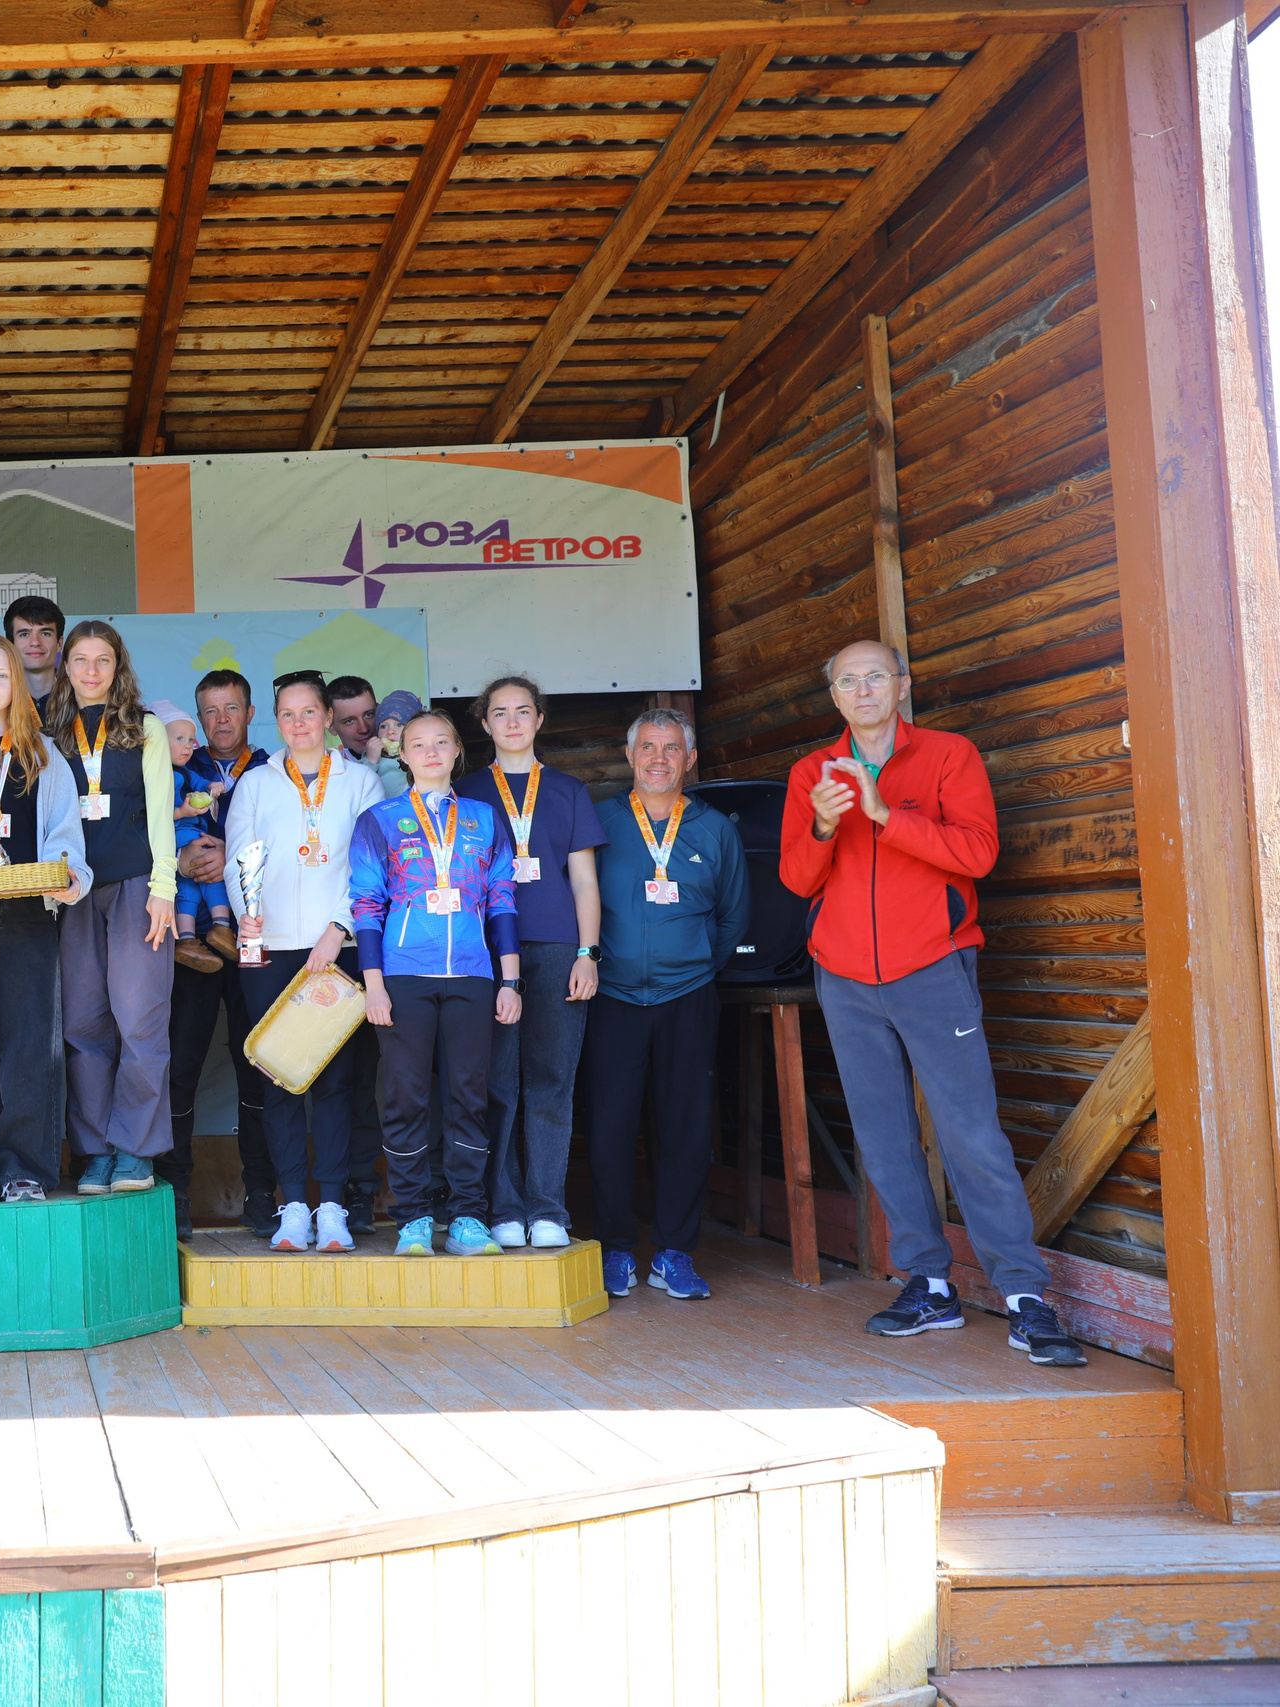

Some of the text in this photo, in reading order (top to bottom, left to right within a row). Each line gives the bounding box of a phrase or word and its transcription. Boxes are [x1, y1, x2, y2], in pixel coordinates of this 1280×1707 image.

[387, 519, 510, 548] РОЗА
[483, 535, 642, 563] ВЕТРОВ
[2, 825, 8, 834] 1
[320, 854, 328, 863] 3
[531, 869, 539, 878] 3
[670, 892, 678, 901] 3
[452, 901, 459, 910] 3
